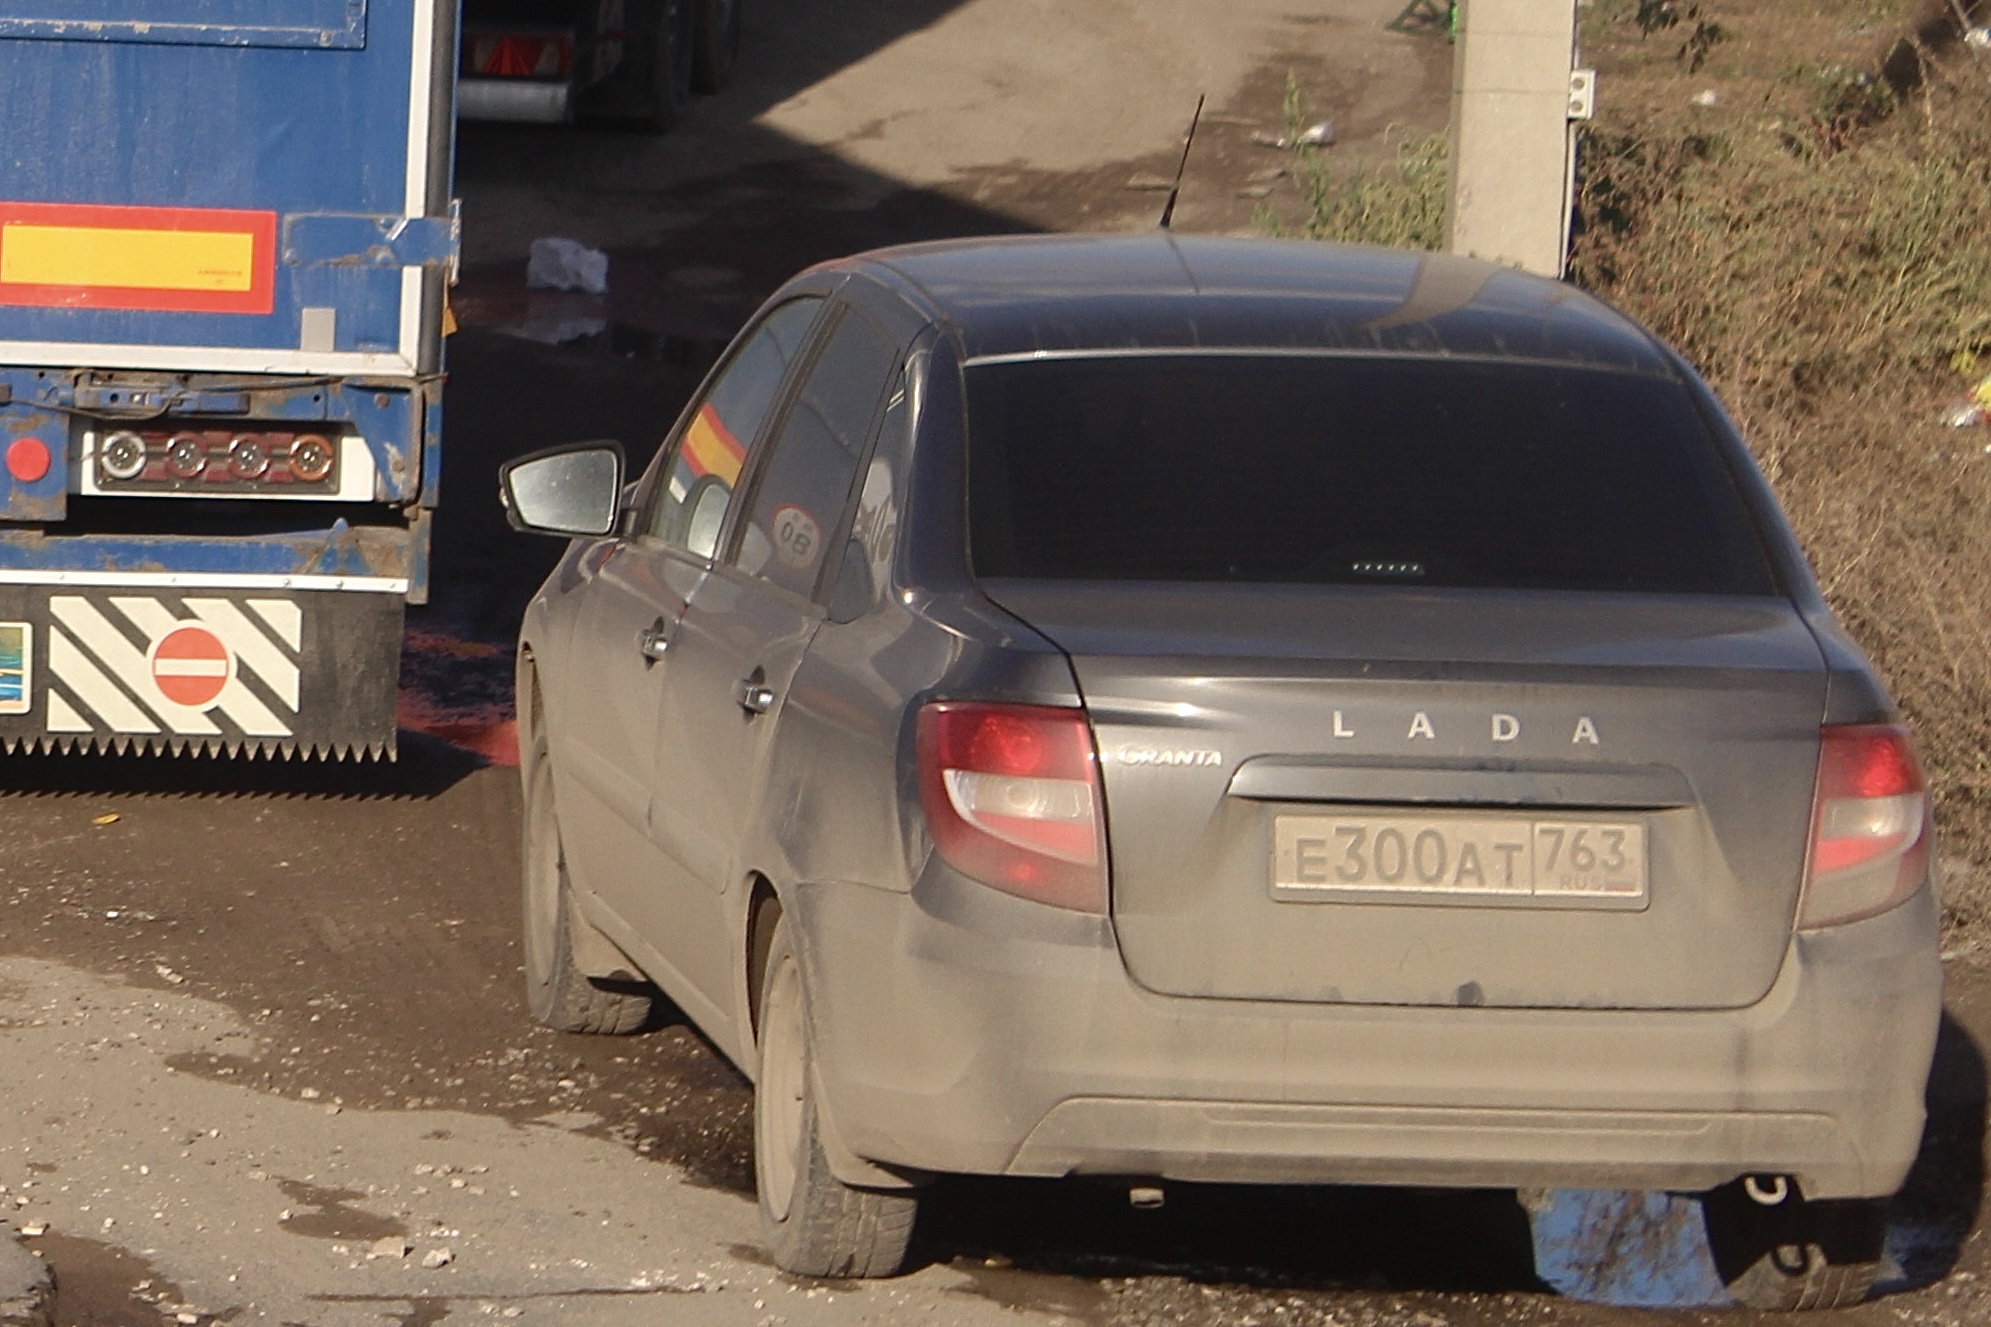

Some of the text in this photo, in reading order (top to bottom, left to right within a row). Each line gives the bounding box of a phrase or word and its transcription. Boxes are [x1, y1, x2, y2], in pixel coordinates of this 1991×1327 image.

[1332, 710, 1600, 745] LADA
[1118, 747, 1223, 767] GRANTA
[1538, 828, 1627, 873] 763
